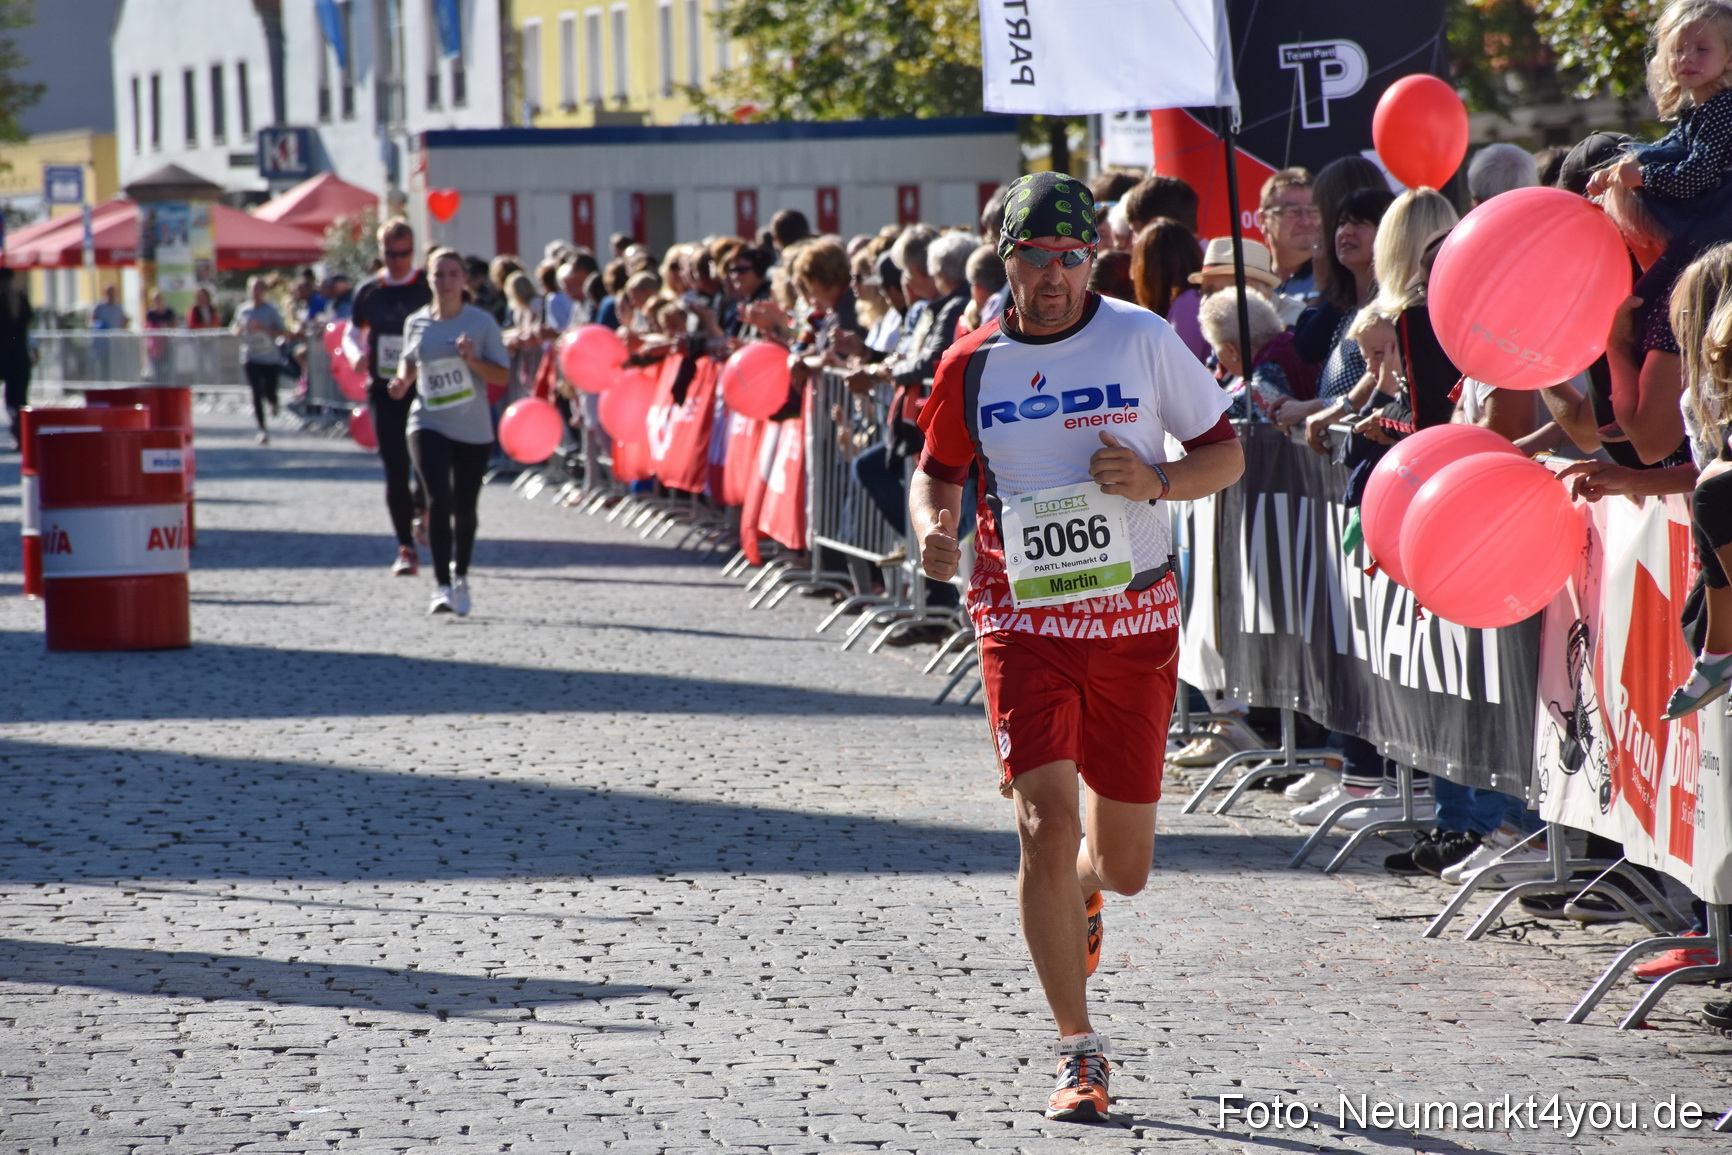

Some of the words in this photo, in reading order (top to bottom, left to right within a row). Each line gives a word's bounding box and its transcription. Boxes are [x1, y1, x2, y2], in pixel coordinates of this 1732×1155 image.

[1286, 50, 1312, 60] Team
[1034, 495, 1088, 514] BOCK
[1022, 514, 1111, 561] 5066
[1034, 563, 1060, 573] PARTL
[1061, 556, 1098, 568] Neumarkt
[1050, 573, 1099, 593] Martin
[1618, 682, 1658, 790] Braun
